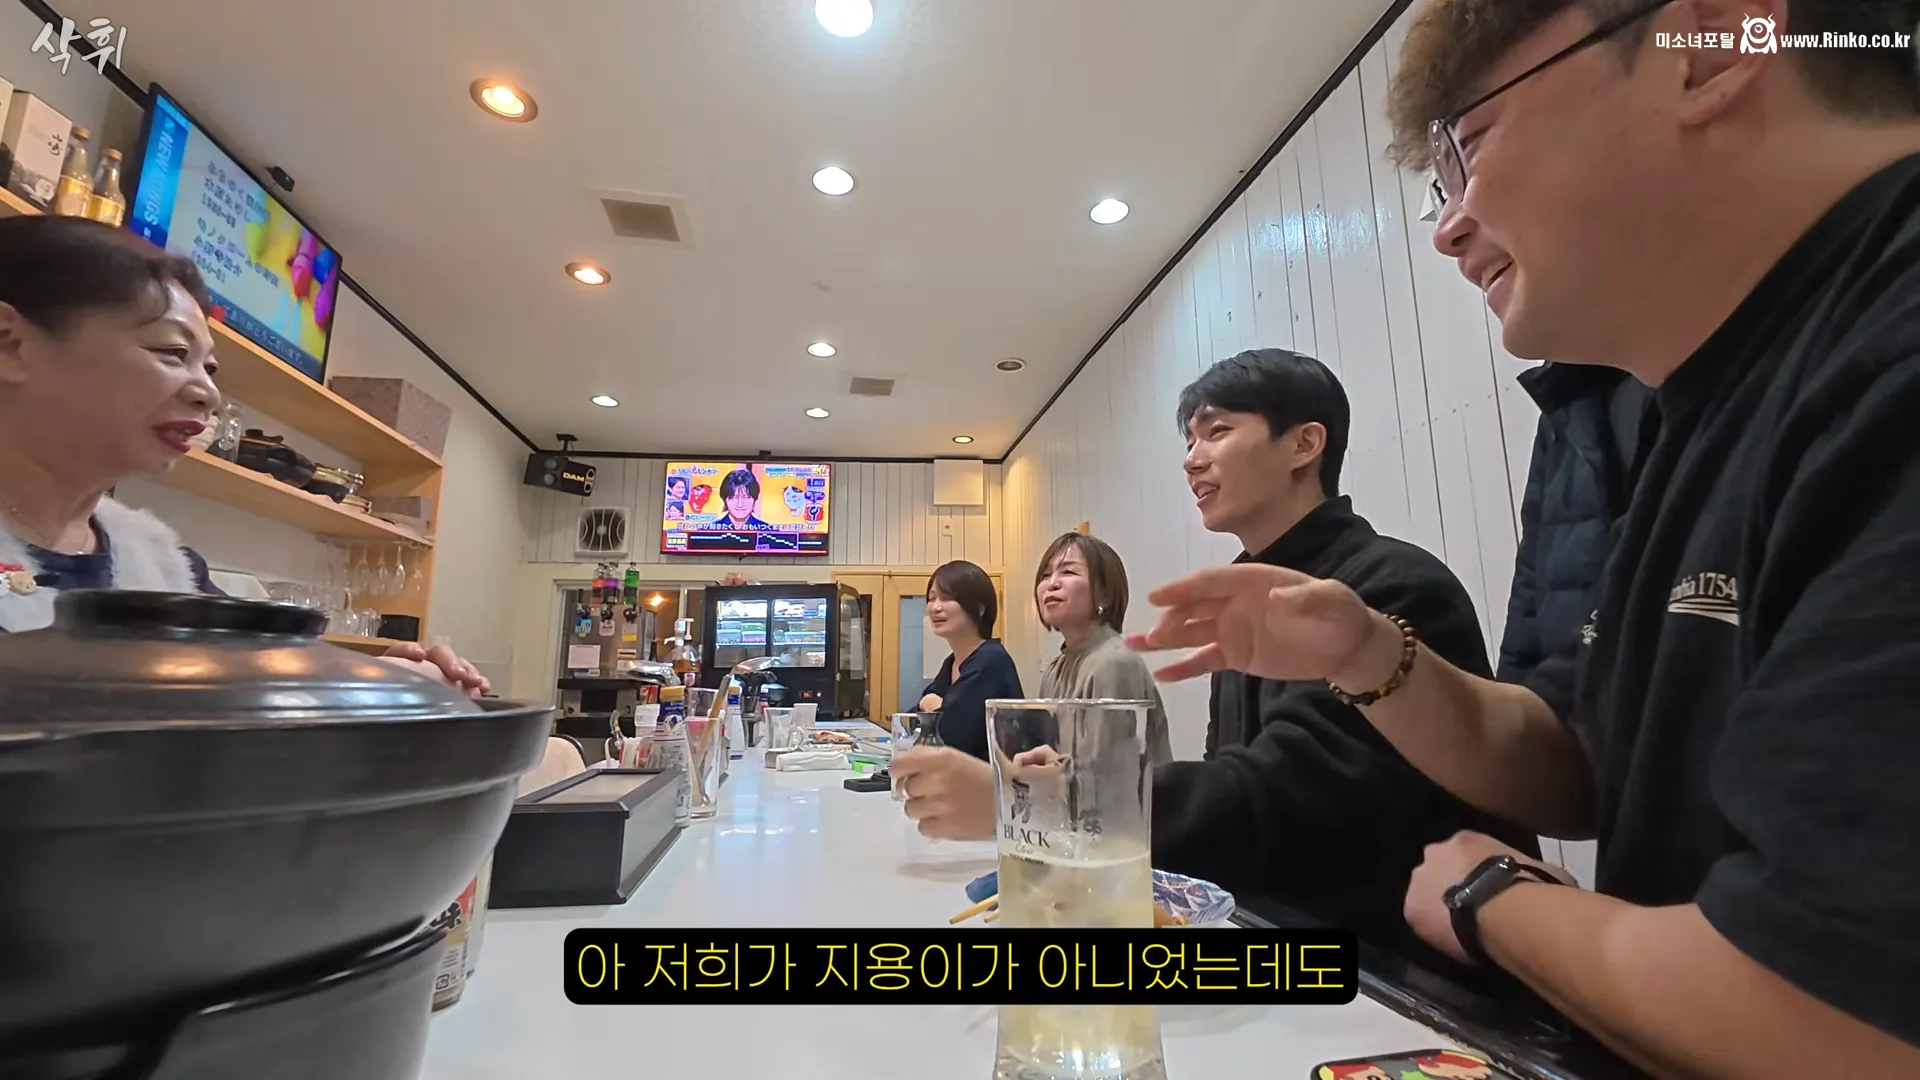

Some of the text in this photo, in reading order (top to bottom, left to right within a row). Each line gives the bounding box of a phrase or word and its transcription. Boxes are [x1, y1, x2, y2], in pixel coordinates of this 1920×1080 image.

[562, 472, 585, 483] DAM
[1699, 572, 1738, 601] 1754
[1004, 823, 1051, 849] BLACK
